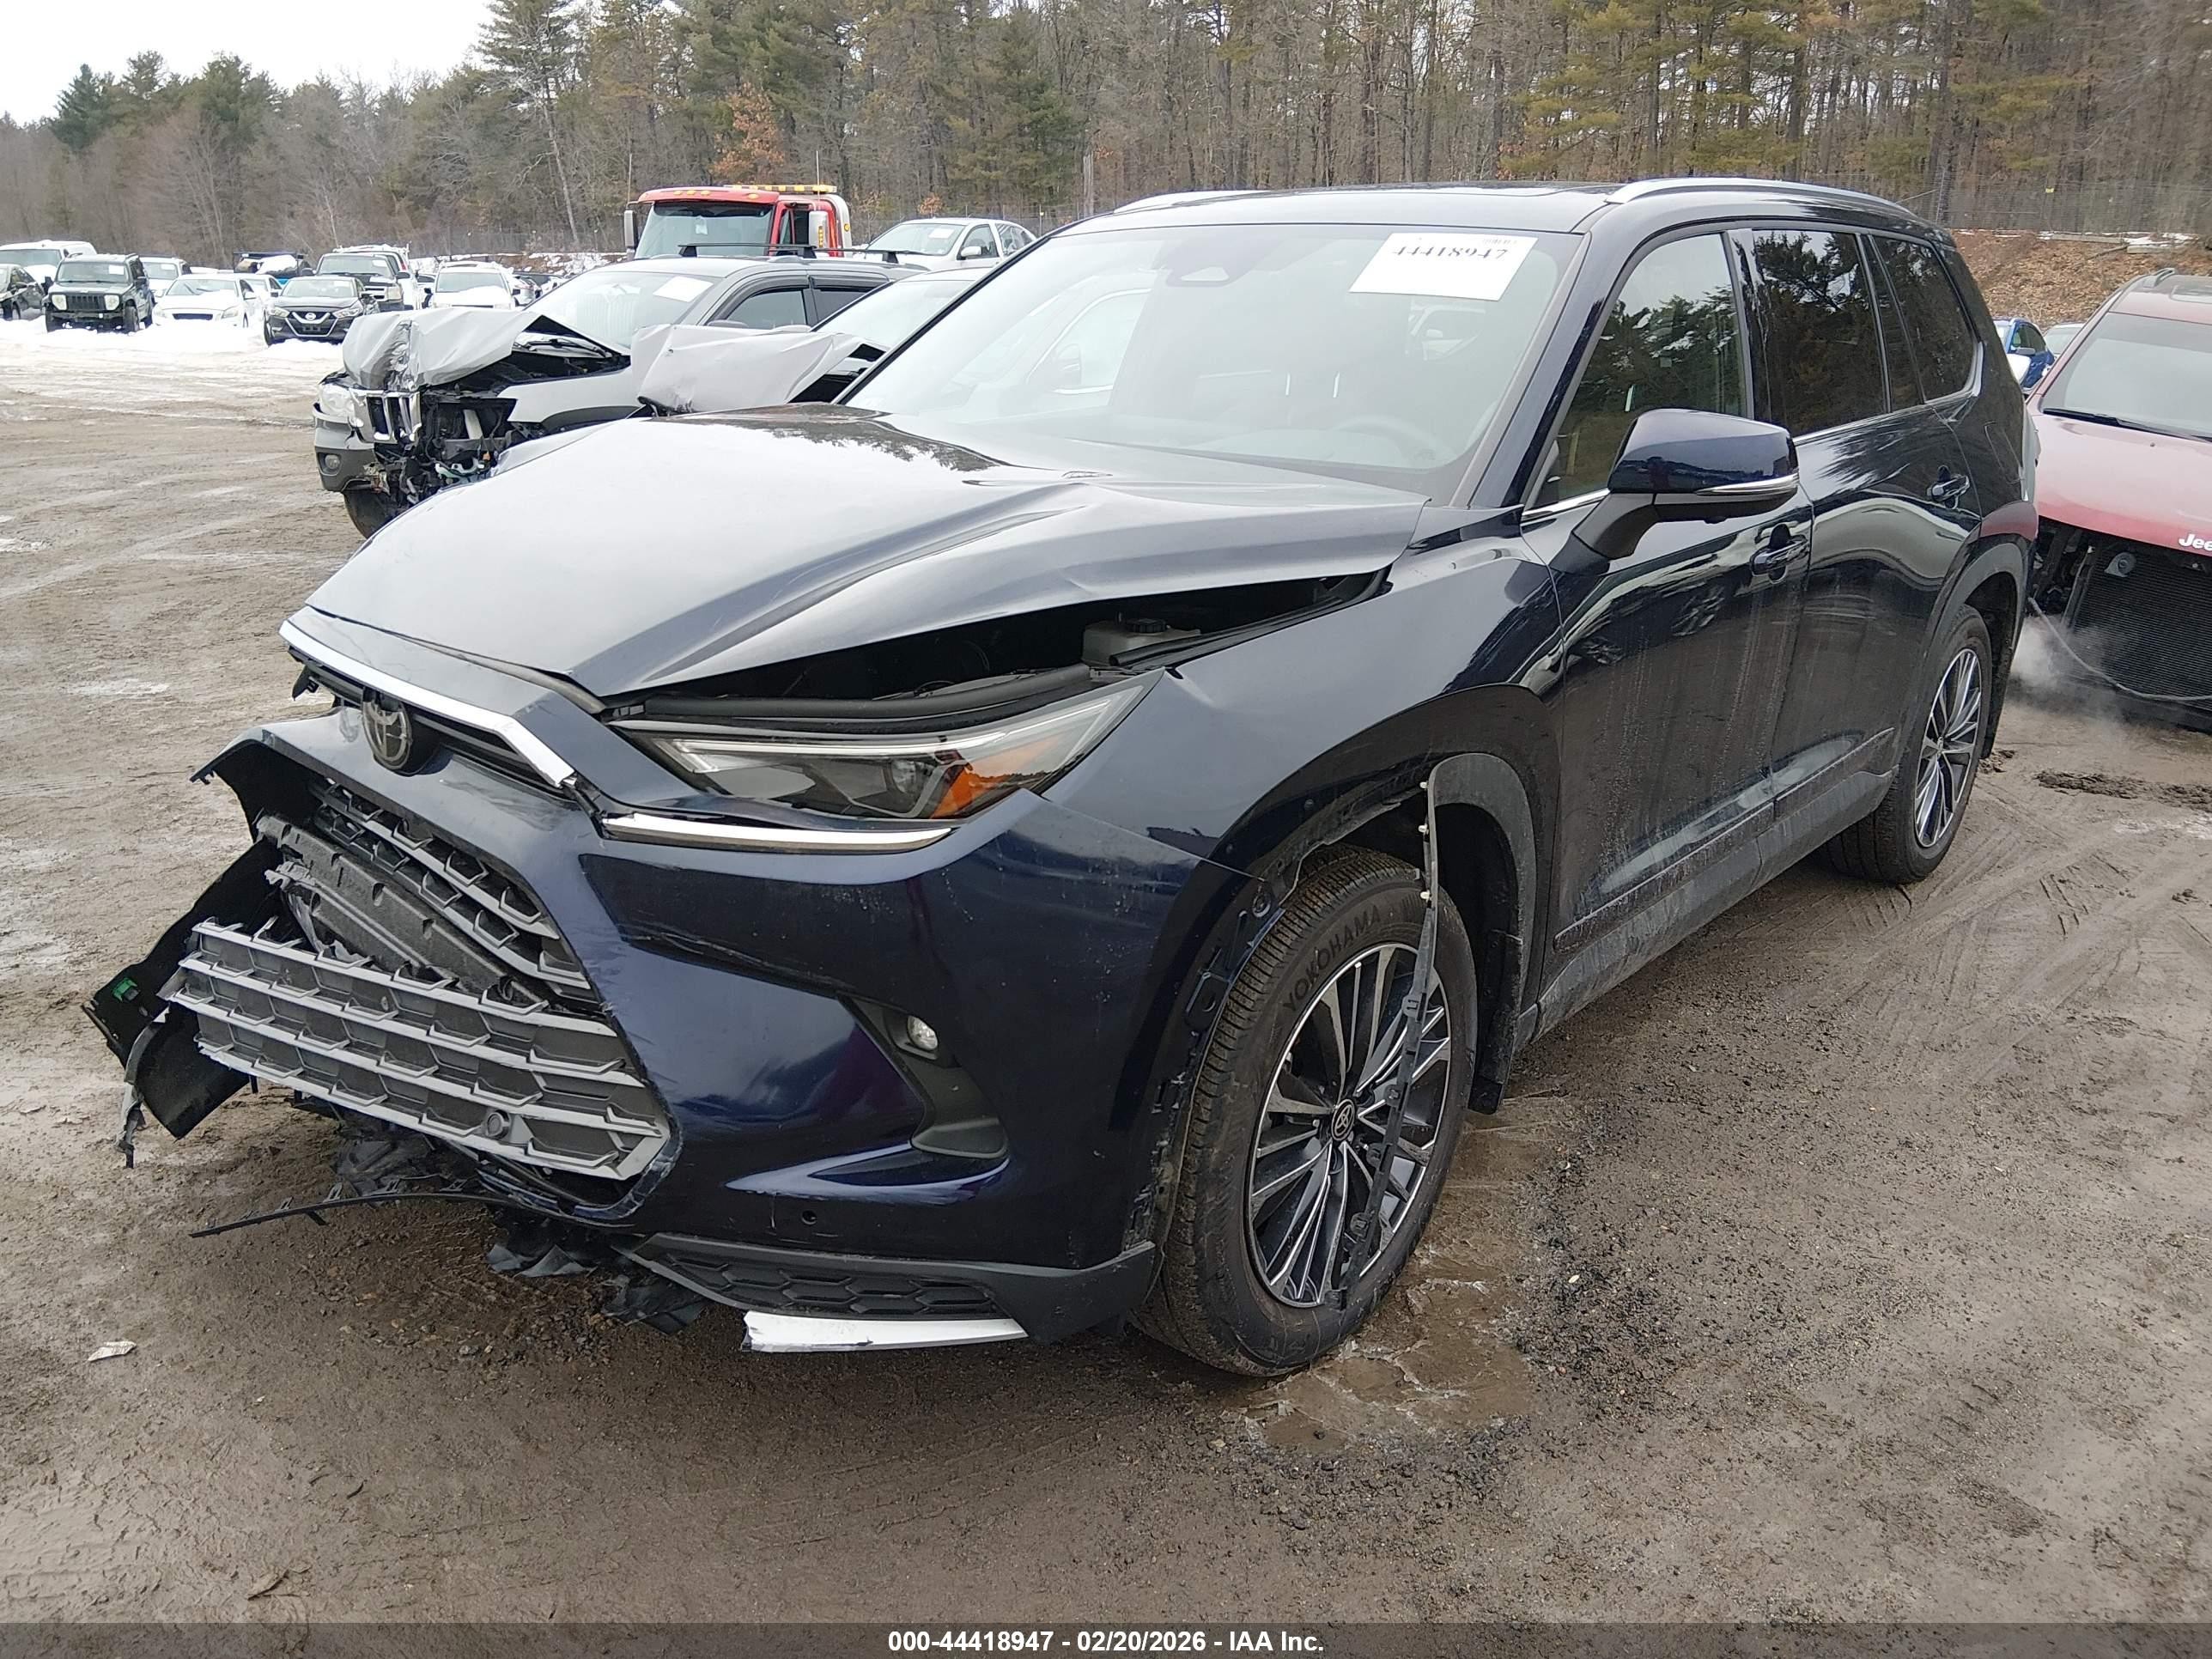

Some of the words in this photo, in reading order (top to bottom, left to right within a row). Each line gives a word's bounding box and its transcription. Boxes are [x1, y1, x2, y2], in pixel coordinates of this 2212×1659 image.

[1392, 245, 1510, 259] 44418947
[2179, 533, 2212, 551] Jee
[1283, 904, 1381, 1012] YOKOHAMA
